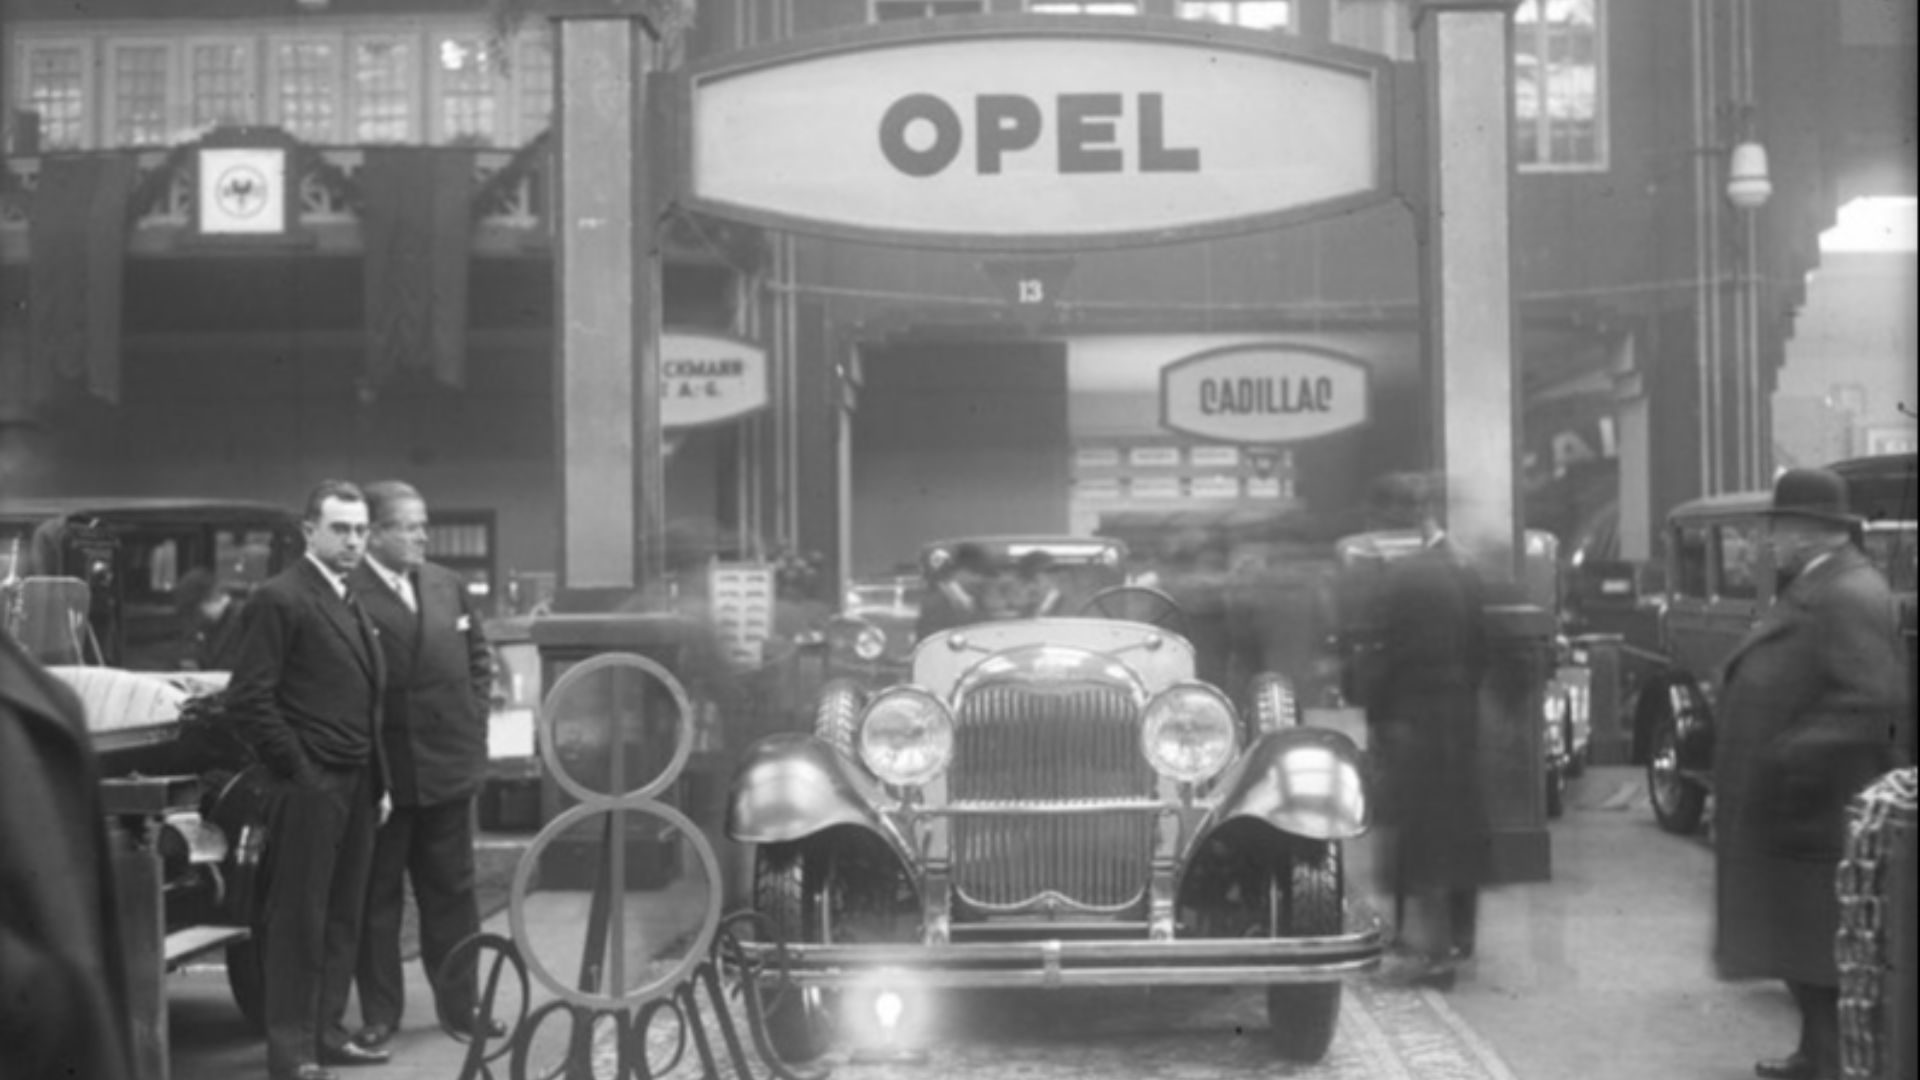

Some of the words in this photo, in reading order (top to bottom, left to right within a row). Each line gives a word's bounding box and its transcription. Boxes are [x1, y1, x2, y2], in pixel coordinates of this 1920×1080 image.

[880, 93, 1200, 176] OPEL
[1019, 279, 1043, 303] 13
[1200, 376, 1332, 414] CADILLAC
